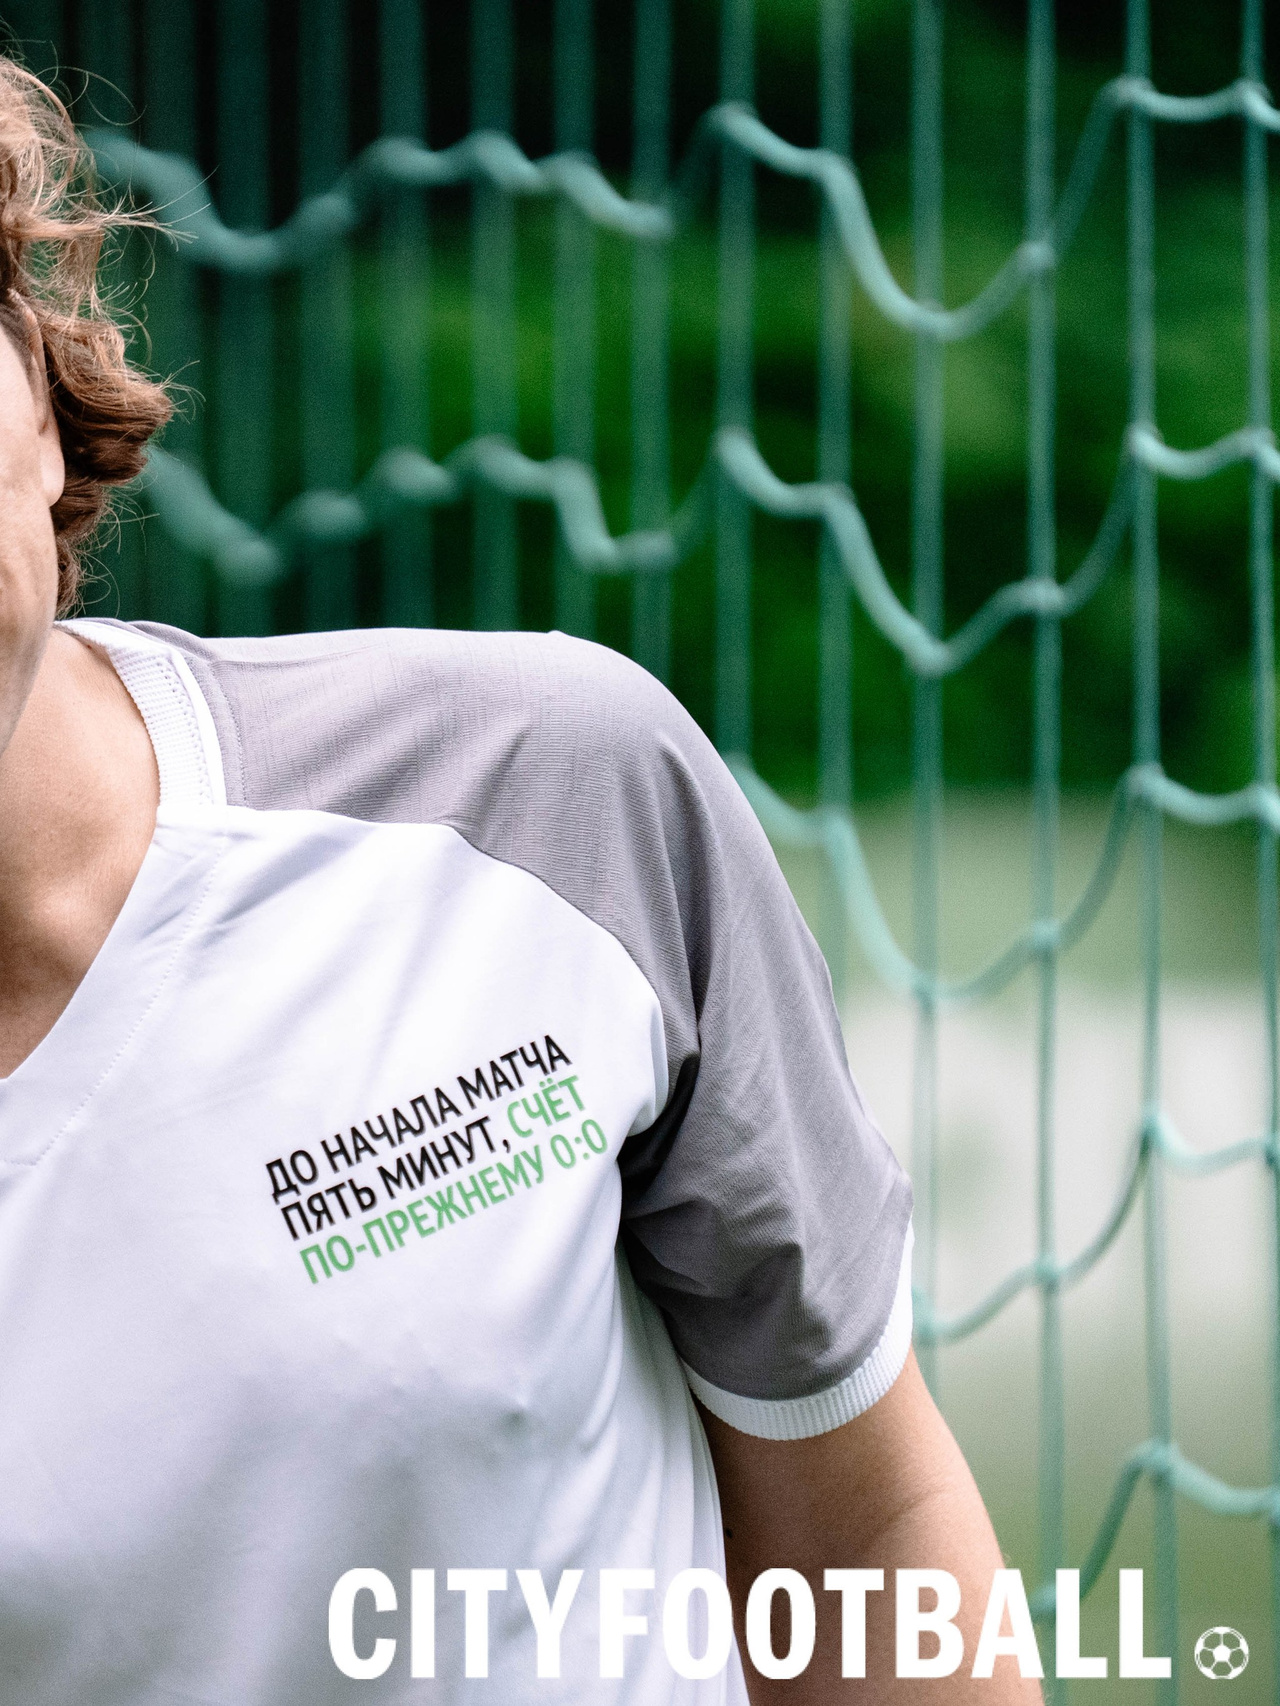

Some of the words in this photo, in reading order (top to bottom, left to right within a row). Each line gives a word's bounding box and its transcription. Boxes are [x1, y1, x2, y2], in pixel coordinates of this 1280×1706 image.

[266, 1149, 319, 1205] ДО
[320, 1087, 463, 1173] НАЧАЛА
[456, 1034, 572, 1110] МАТЧА
[281, 1178, 377, 1241] ПЯТЬ
[376, 1116, 511, 1200] МИНУТ,
[507, 1075, 587, 1138] СЧЁТ
[299, 1145, 545, 1285] ПО-ПРЕЖНЕМУ
[550, 1119, 608, 1169] 0:0
